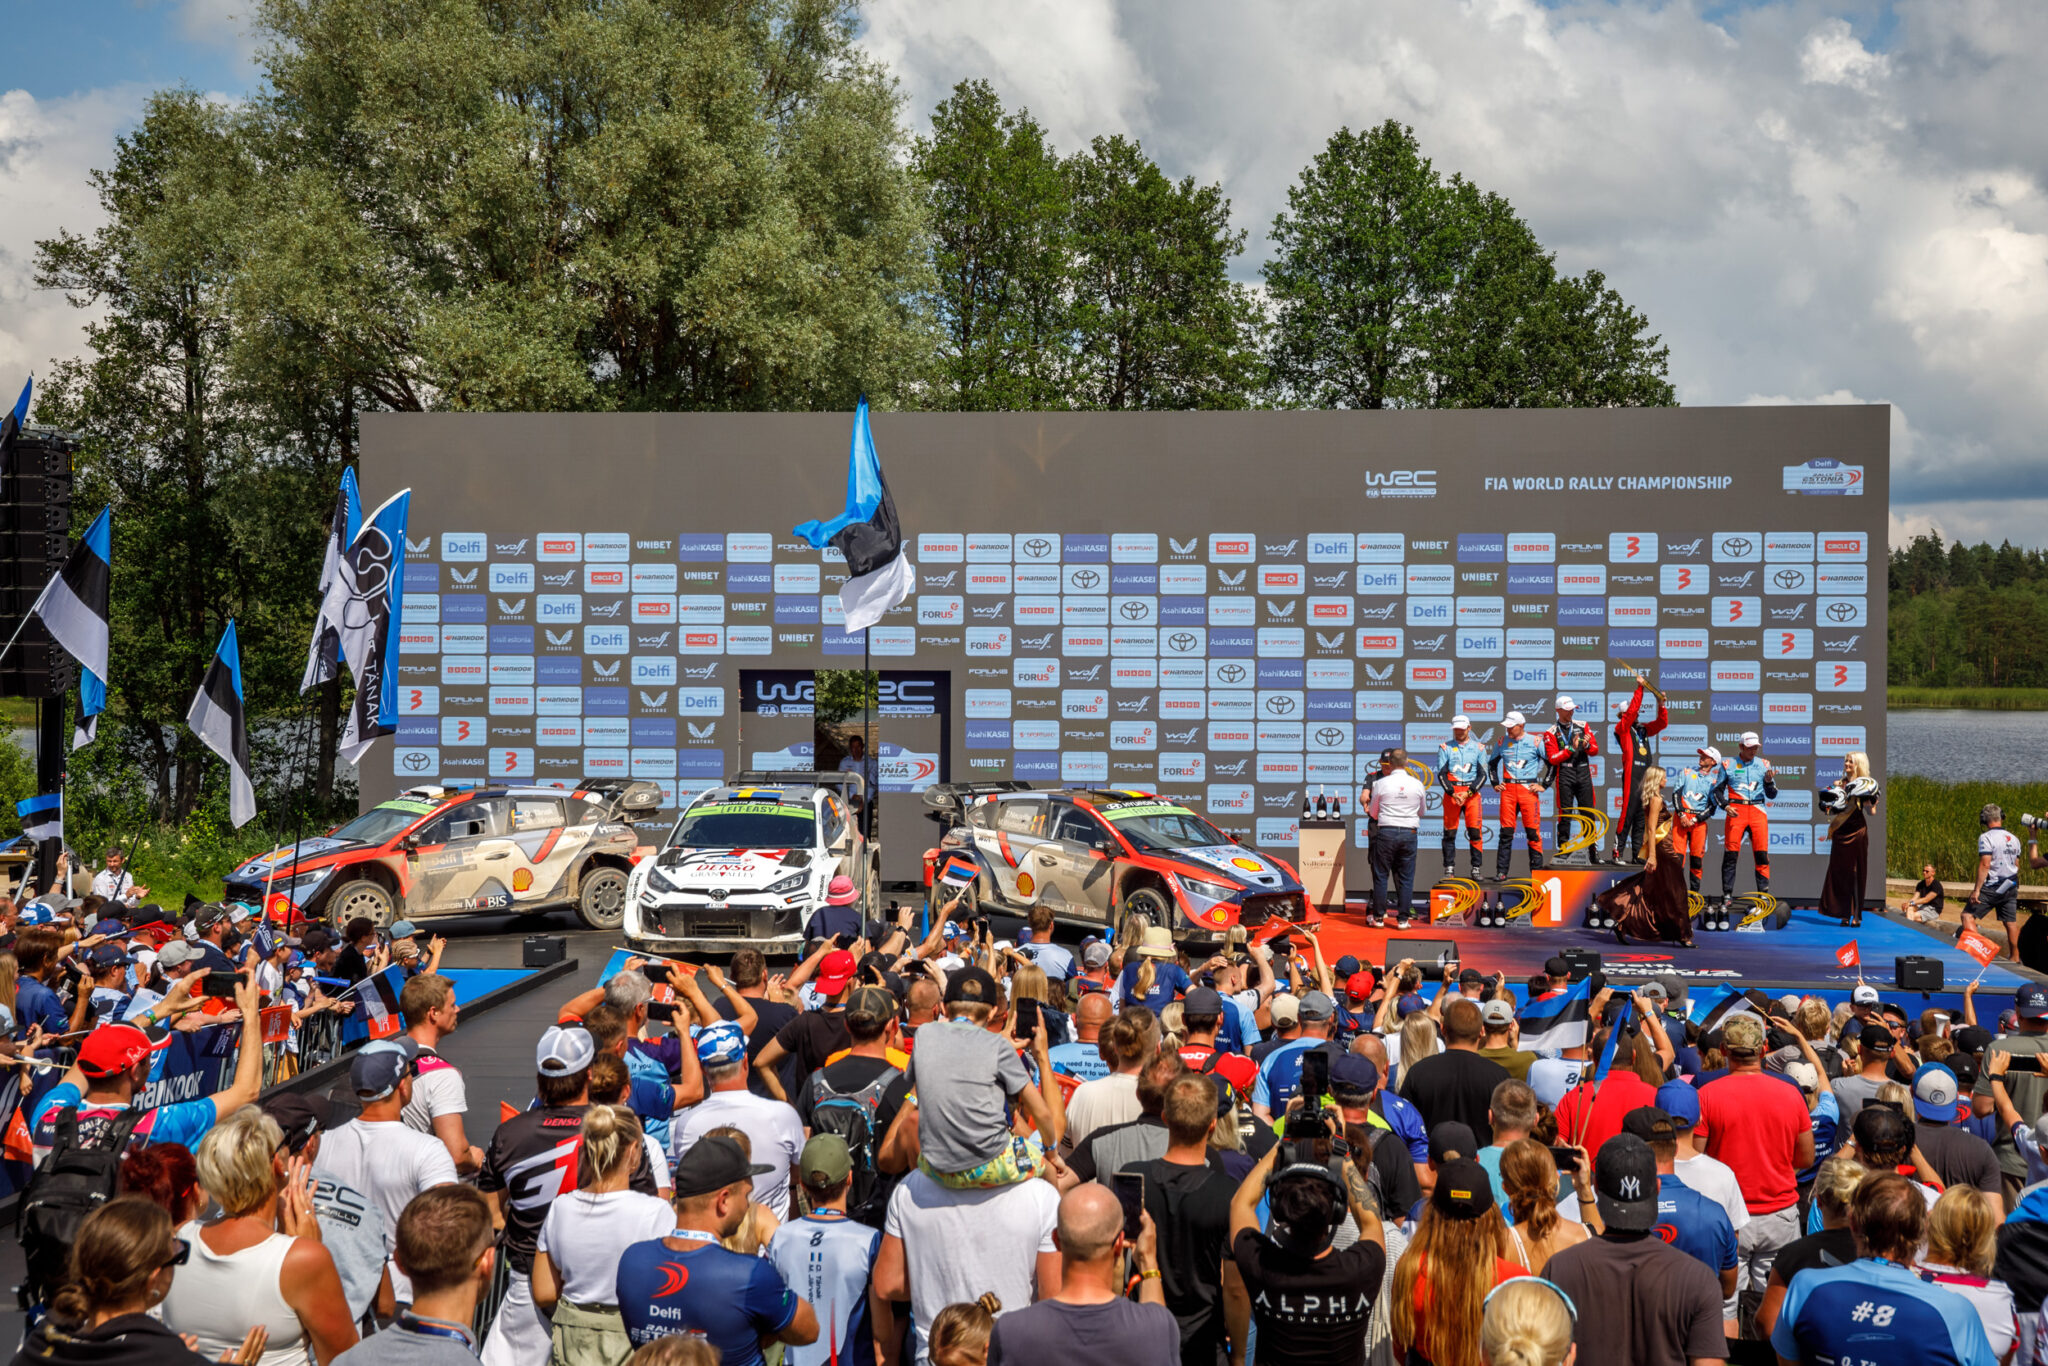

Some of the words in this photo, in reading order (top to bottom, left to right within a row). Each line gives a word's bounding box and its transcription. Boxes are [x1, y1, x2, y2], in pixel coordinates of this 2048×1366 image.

[1365, 470, 1437, 486] WRC
[1485, 477, 1508, 490] FIA
[1512, 477, 1564, 490] WORLD
[1569, 476, 1613, 490] RALLY
[1618, 475, 1733, 489] CHAMPIONSHIP
[448, 542, 480, 552] Delfi
[637, 541, 671, 549] UNIBET
[1315, 542, 1347, 552] Delfi
[1412, 541, 1448, 549] UNIBET
[496, 573, 527, 583] Delfi
[685, 572, 719, 580] UNIBET
[1364, 573, 1397, 584] Delfi
[1462, 573, 1499, 581] UNIBET
[543, 604, 575, 614] Delfi
[732, 603, 767, 611] UNIBET
[1413, 605, 1446, 616] Delfi
[1513, 605, 1549, 613] UNIBET
[922, 610, 953, 618] FORUS
[591, 635, 623, 645] Delfi
[779, 634, 814, 642] UNIBET
[1463, 637, 1496, 648] Delfi
[1563, 637, 1599, 645] UNIBET
[638, 666, 670, 676] Delfi
[1514, 669, 1547, 680] Delfi
[1018, 673, 1050, 681] FORUS
[686, 697, 717, 707] Delfi
[1664, 701, 1702, 710] UNIBET
[1115, 736, 1146, 744] FORUS
[1163, 768, 1195, 776] FORUS
[1212, 798, 1242, 808] FORUS
[1262, 832, 1293, 841] FORUS
[1770, 833, 1805, 846] Delfi
[816, 873, 826, 902] Panasonic
[464, 895, 507, 911] MOBIS
[1540, 876, 1562, 922] 1
[639, 1063, 652, 1071] you
[1565, 1072, 1578, 1084] 8
[543, 1117, 582, 1126] DENSO
[810, 1231, 823, 1247] 8
[1255, 1290, 1370, 1314] ALPHA
[649, 1305, 682, 1321] Delfi
[1852, 1300, 1896, 1327] #8
[646, 1324, 686, 1335] RALLY
